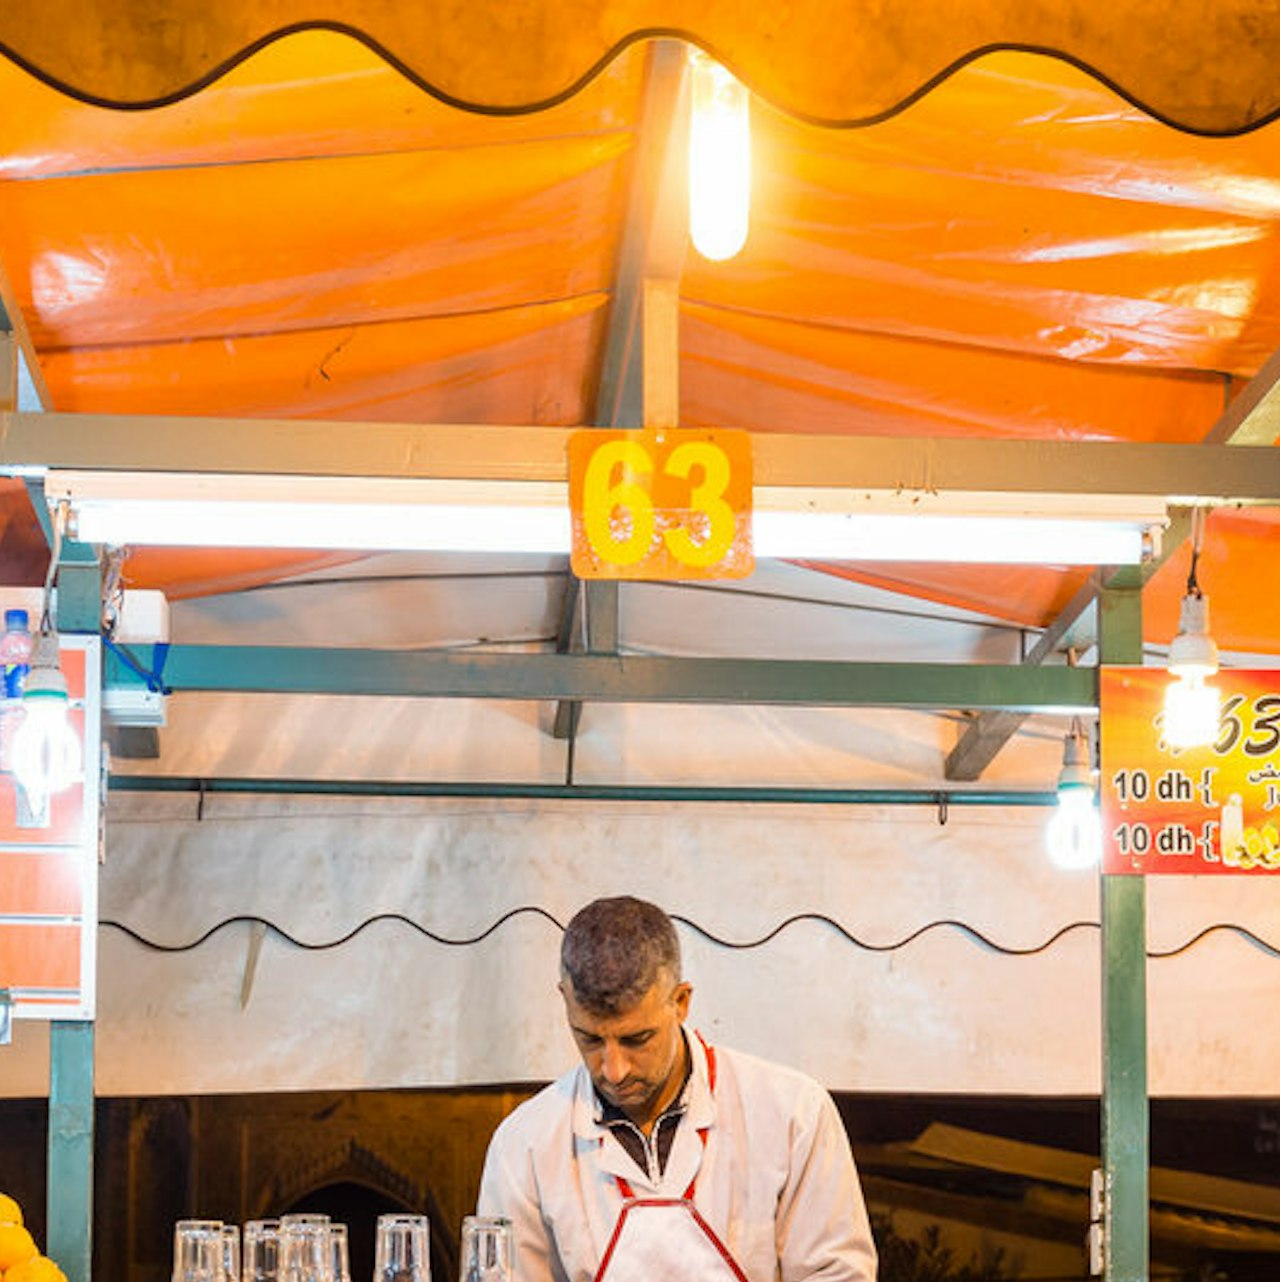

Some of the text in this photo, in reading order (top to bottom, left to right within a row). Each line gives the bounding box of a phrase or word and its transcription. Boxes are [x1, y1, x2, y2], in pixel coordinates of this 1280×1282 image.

[583, 440, 736, 567] 63
[1114, 772, 1191, 800] 10 dh
[1115, 826, 1194, 852] 10 dh
